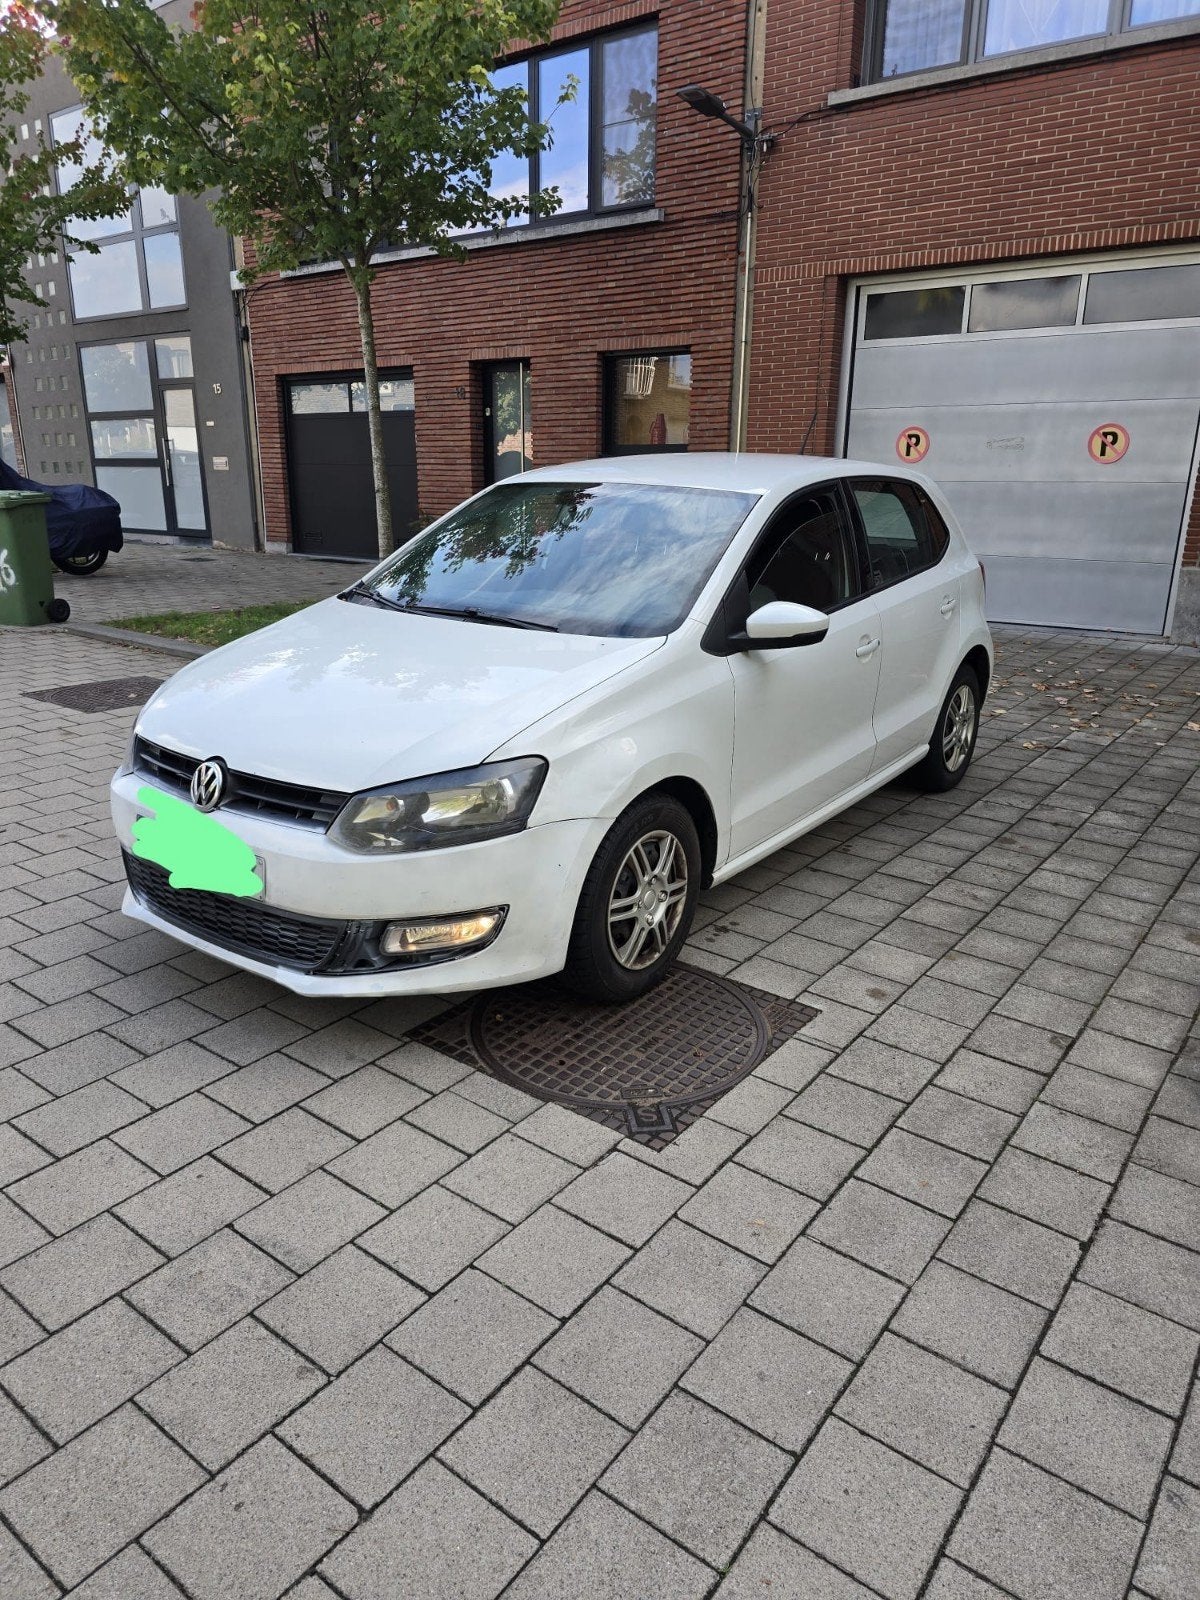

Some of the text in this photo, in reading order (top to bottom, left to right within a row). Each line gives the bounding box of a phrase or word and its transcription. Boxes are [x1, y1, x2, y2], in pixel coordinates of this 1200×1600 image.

[212, 383, 222, 394] 15
[905, 433, 921, 457] P
[1099, 431, 1119, 457] P
[637, 1107, 658, 1122] S
